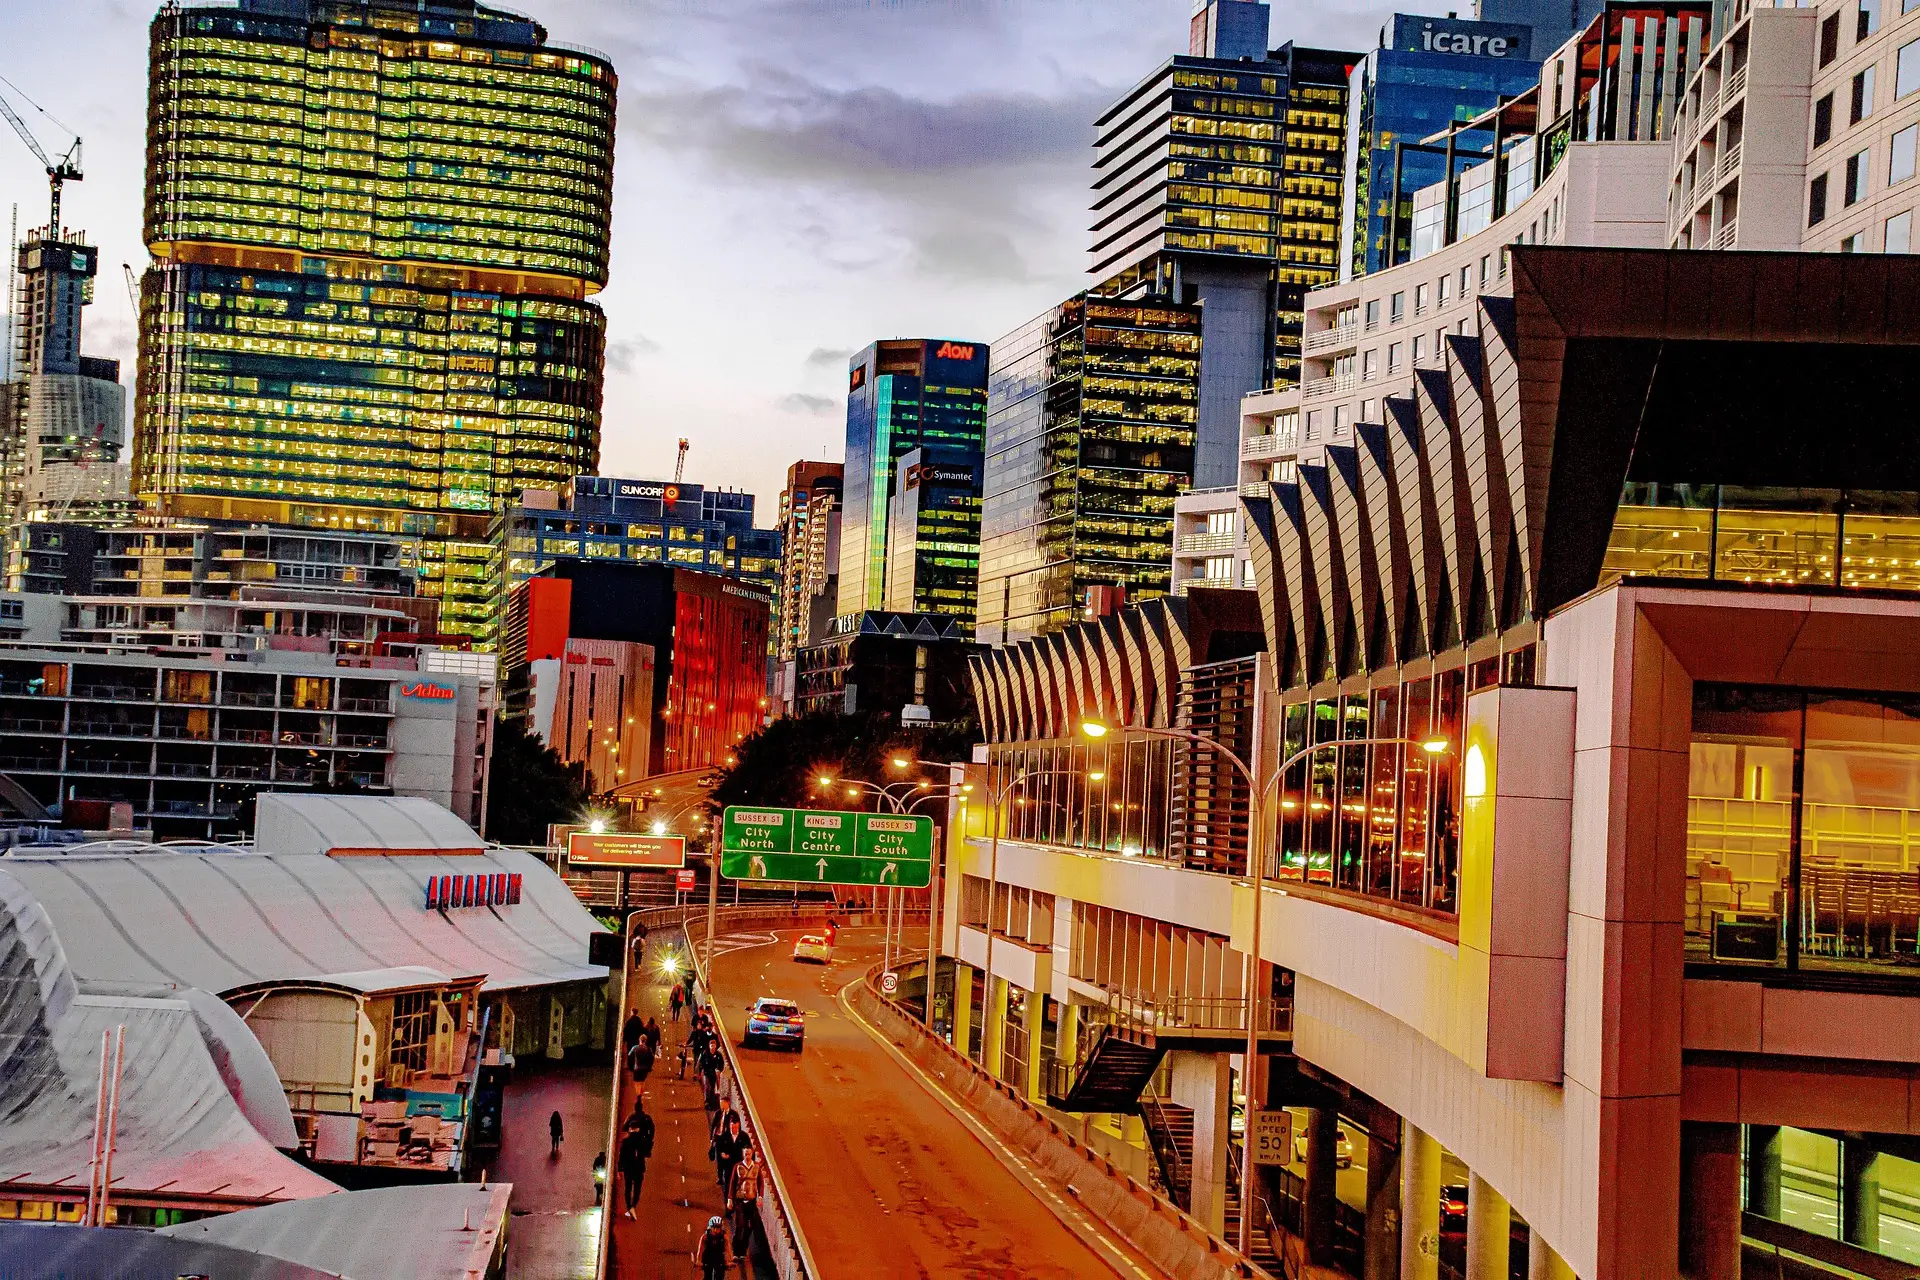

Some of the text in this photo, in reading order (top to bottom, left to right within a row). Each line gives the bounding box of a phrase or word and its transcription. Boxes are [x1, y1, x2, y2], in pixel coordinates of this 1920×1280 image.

[1422, 22, 1507, 57] icare
[934, 470, 973, 481] Symantec
[620, 485, 664, 497] SUNCORP
[749, 591, 770, 604] EXPRESS
[401, 682, 455, 699] Adina
[737, 814, 767, 824] SUSSEX
[806, 818, 825, 826] KING
[870, 820, 913, 830] SUSSEX ST
[745, 827, 771, 838] City
[809, 830, 835, 842] City
[740, 838, 774, 849] North
[878, 833, 904, 845] City
[801, 841, 841, 852] Centre
[873, 845, 908, 855] South
[1261, 1115, 1282, 1123] EXIT
[1256, 1125, 1287, 1134] SPEED
[1259, 1136, 1282, 1150] 50
